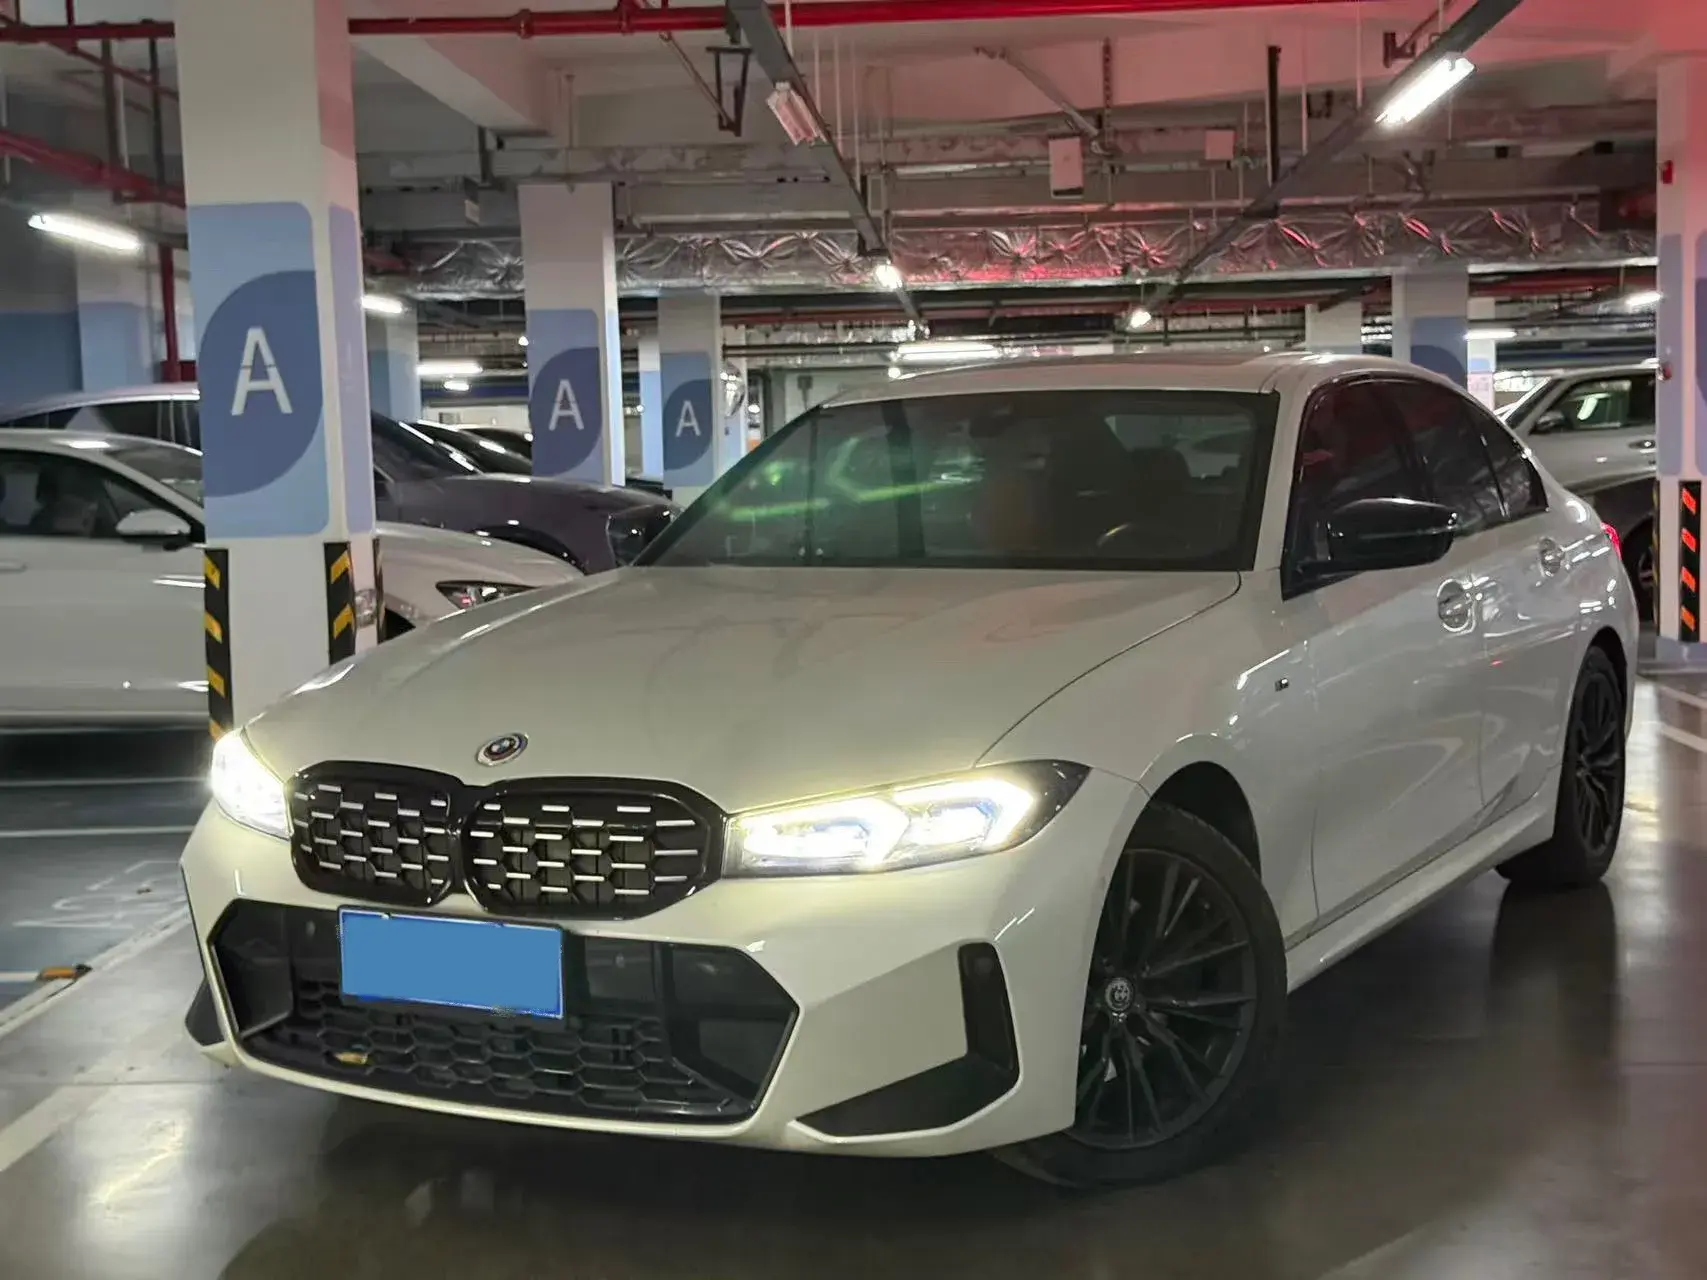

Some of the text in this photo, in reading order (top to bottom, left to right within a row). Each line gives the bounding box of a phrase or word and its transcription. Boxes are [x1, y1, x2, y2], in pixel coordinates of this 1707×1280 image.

[231, 327, 293, 416] A
[549, 379, 585, 431] A
[675, 400, 702, 437] A
